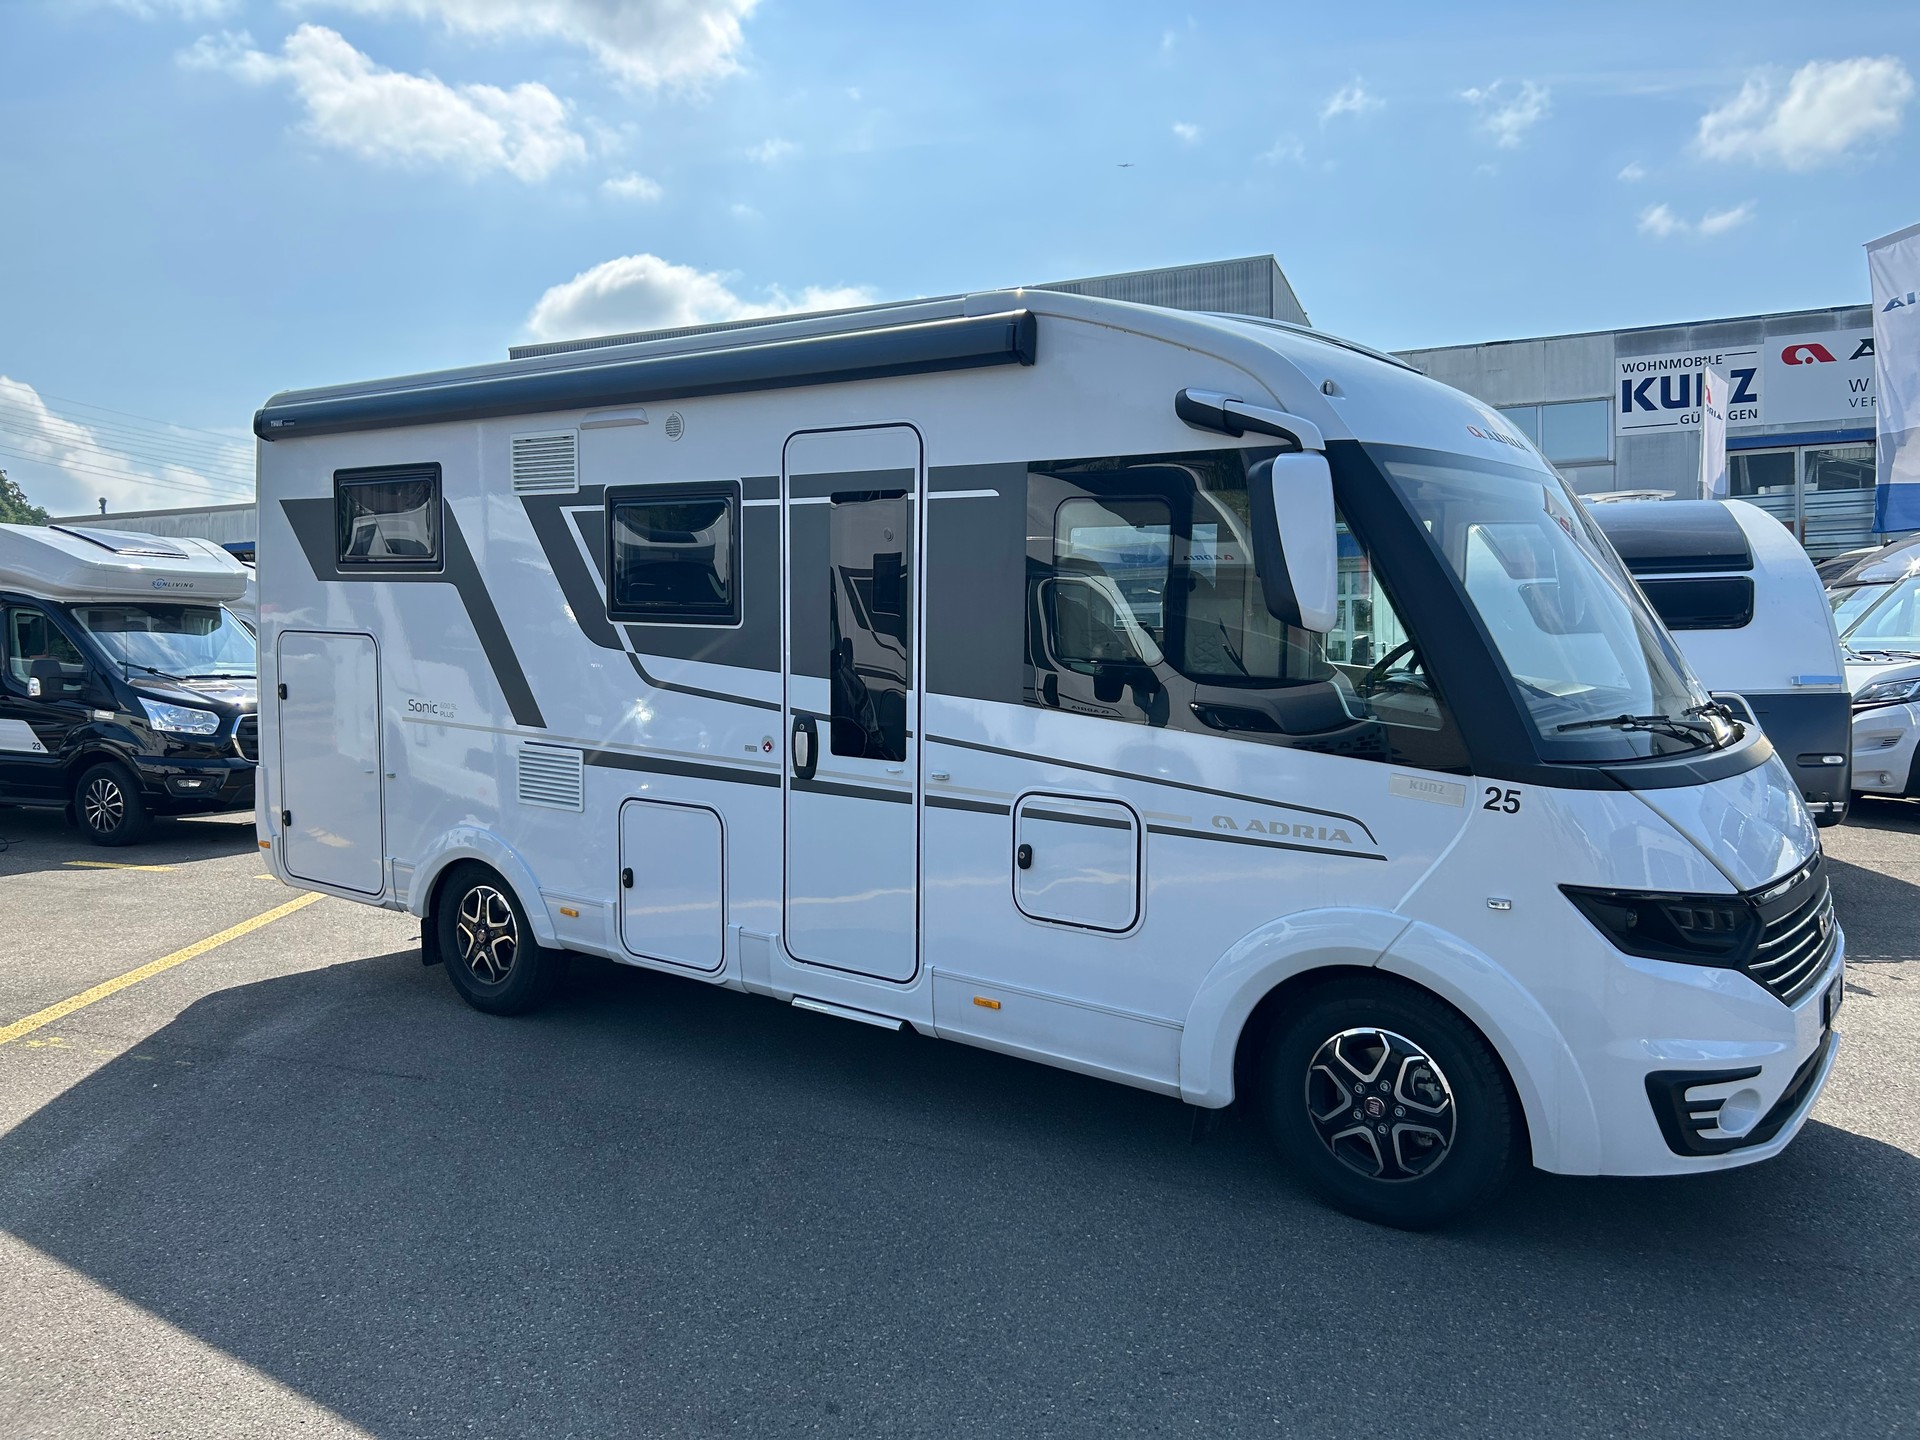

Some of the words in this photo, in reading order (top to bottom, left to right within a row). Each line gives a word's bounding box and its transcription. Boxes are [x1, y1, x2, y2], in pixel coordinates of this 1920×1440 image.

[151, 578, 195, 589] SUNLIVING
[408, 699, 438, 714] Sonic
[32, 742, 41, 750] 23
[1483, 786, 1521, 814] 25
[1245, 819, 1353, 844] ADRIA
